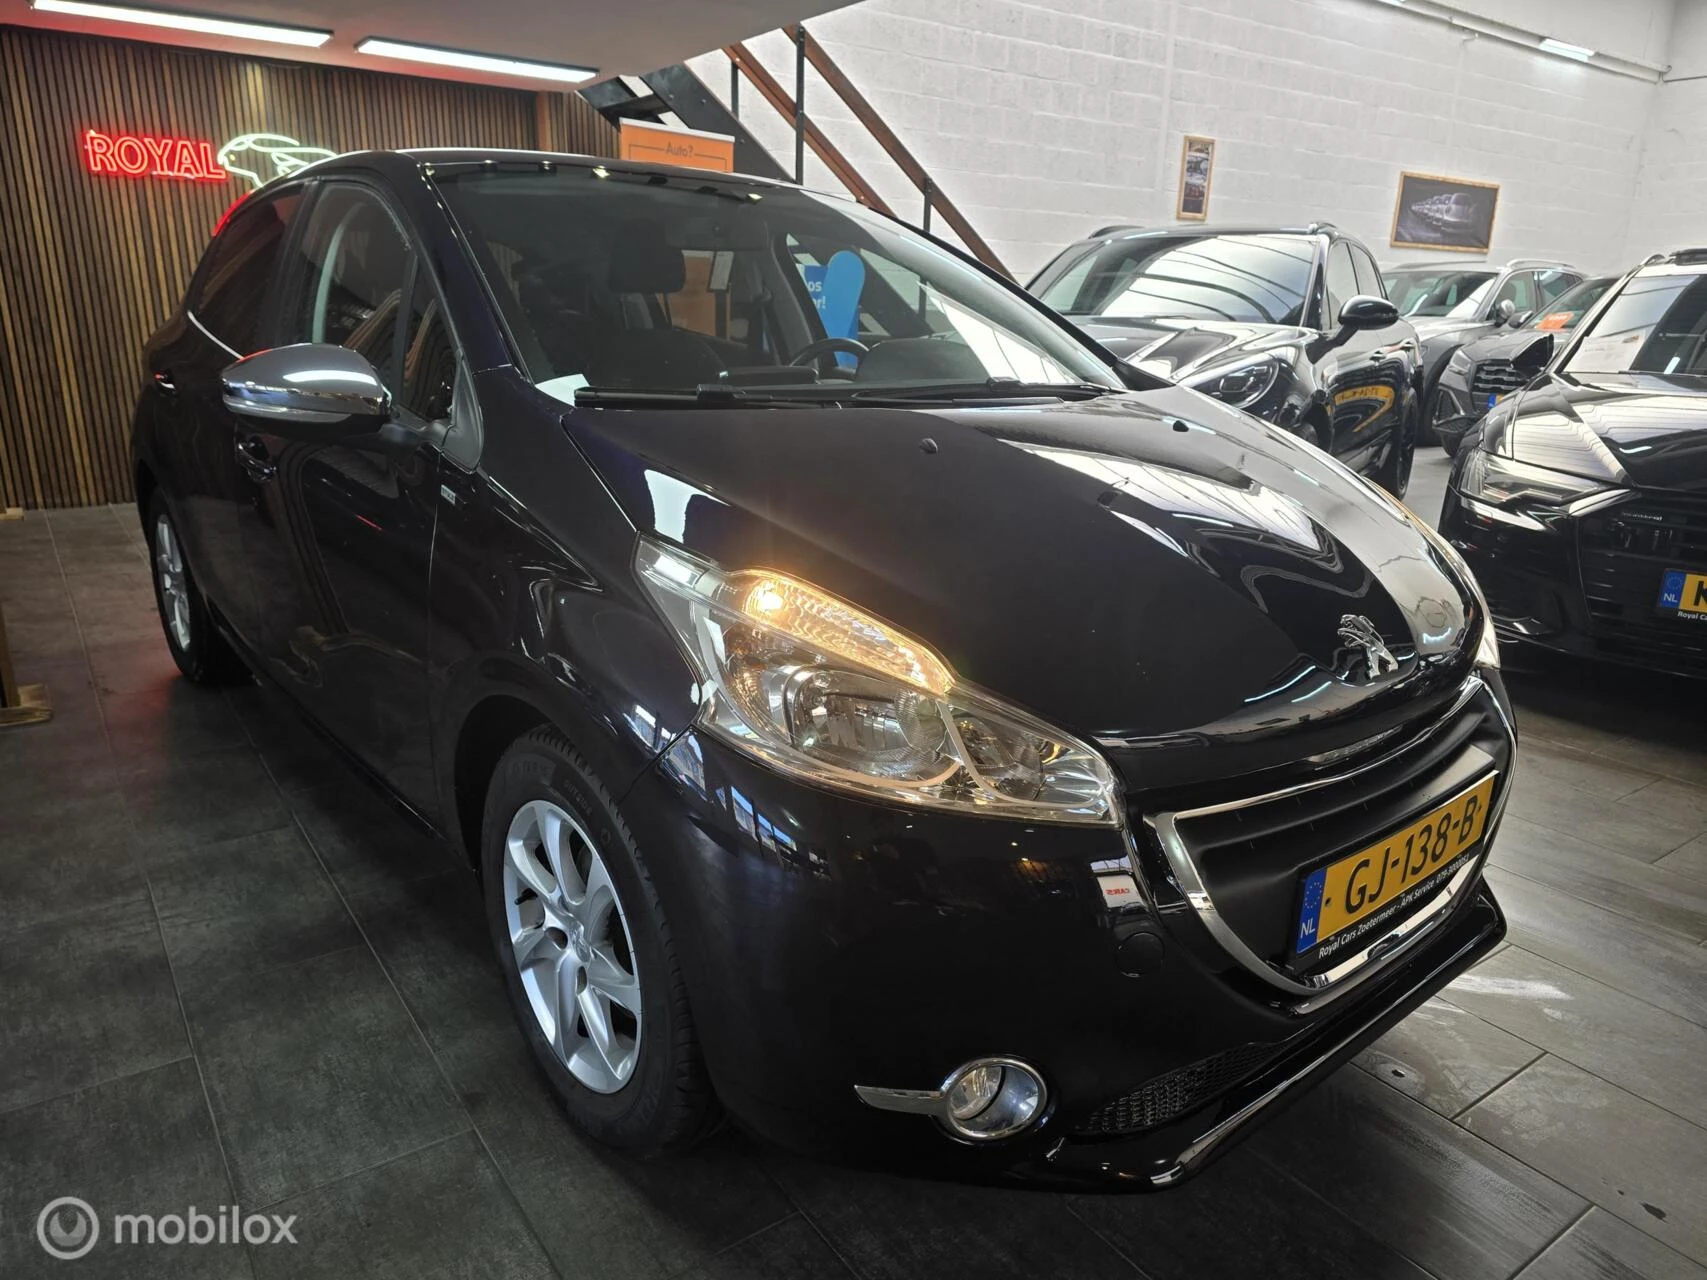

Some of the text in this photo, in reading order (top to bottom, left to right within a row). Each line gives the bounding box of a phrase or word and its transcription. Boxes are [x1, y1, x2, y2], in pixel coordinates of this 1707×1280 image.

[86, 133, 227, 180] ROYAL
[665, 142, 694, 158] Auto?
[1663, 592, 1679, 603] NL
[1677, 610, 1699, 620] Royal
[1345, 795, 1477, 914] GJ-138-B
[1300, 917, 1317, 940] NL
[1318, 937, 1341, 959] Royal
[1341, 927, 1357, 945] Cars
[1357, 904, 1396, 935] Zoetermeer
[1400, 891, 1414, 908] APK
[1413, 880, 1436, 900] Service
